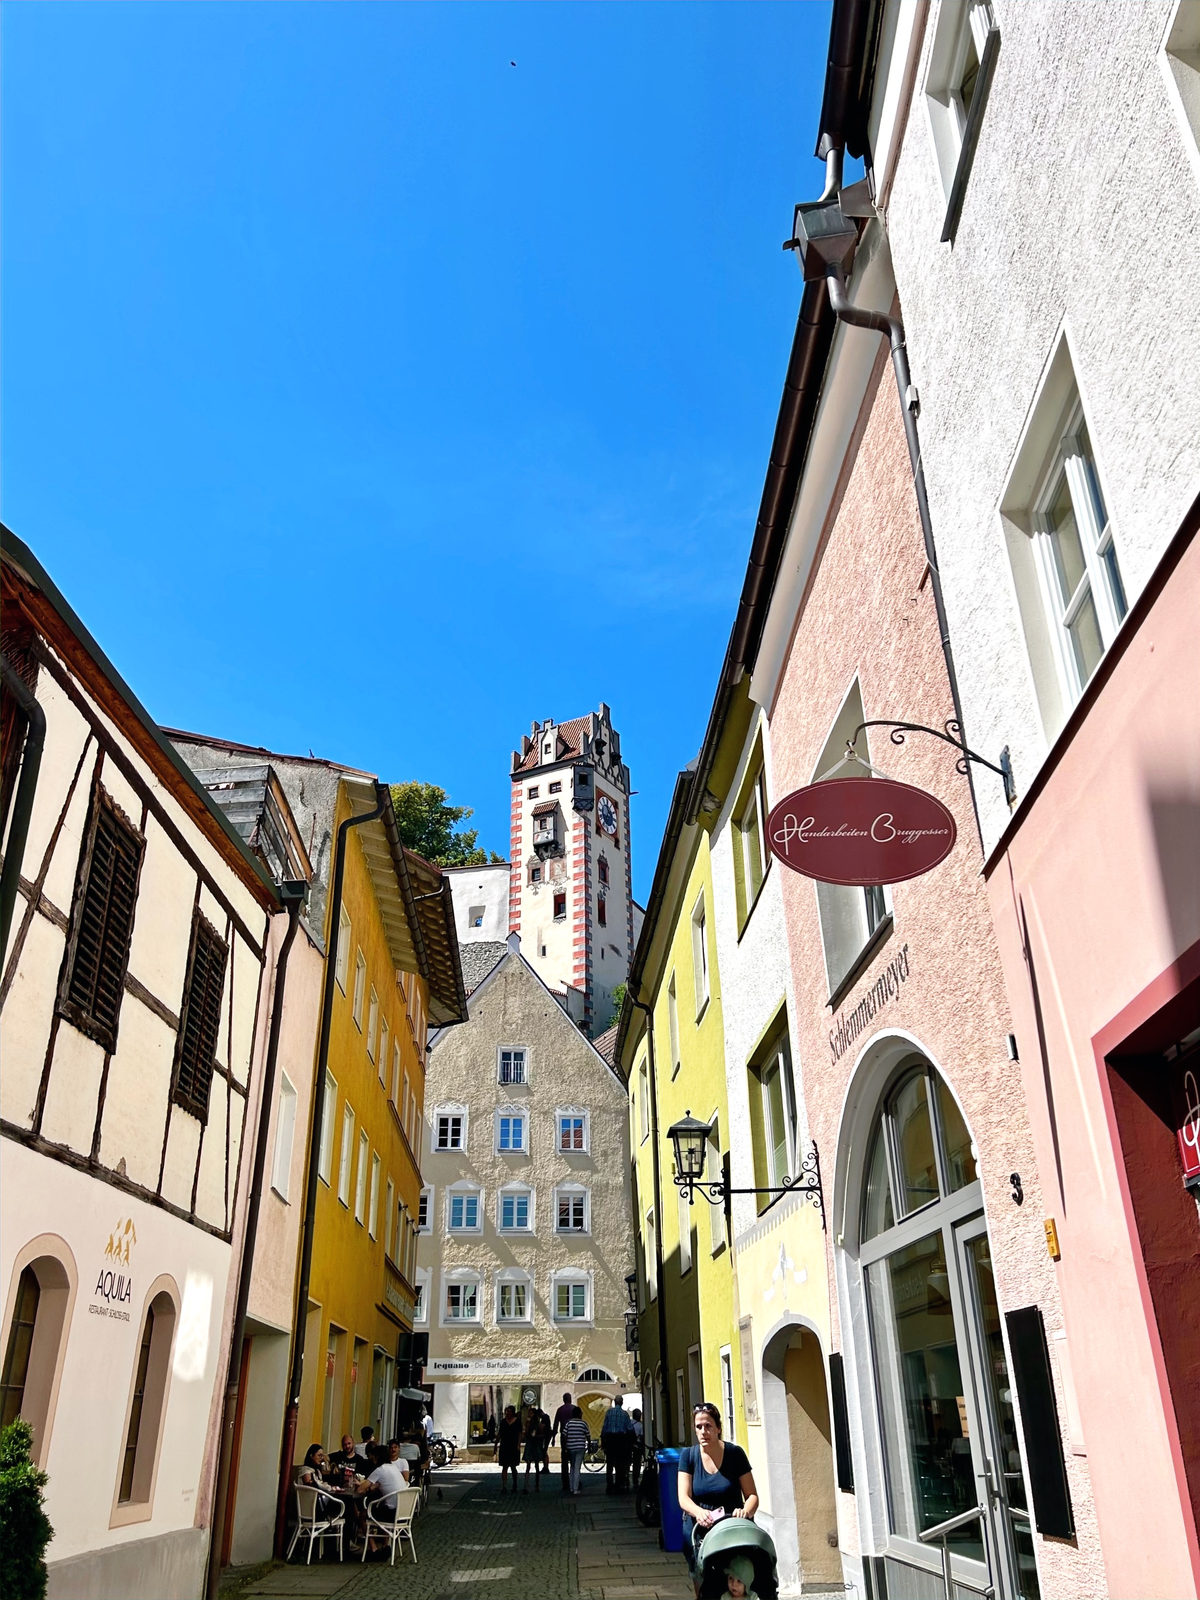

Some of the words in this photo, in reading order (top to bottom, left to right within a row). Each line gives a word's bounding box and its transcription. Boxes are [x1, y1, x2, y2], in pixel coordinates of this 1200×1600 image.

[773, 813, 868, 855] Handarbeiten
[871, 813, 949, 843] Bruggesser
[828, 943, 910, 1067] Schlemmermeyer
[95, 1269, 132, 1303] AQUILA
[433, 1362, 469, 1370] leguano
